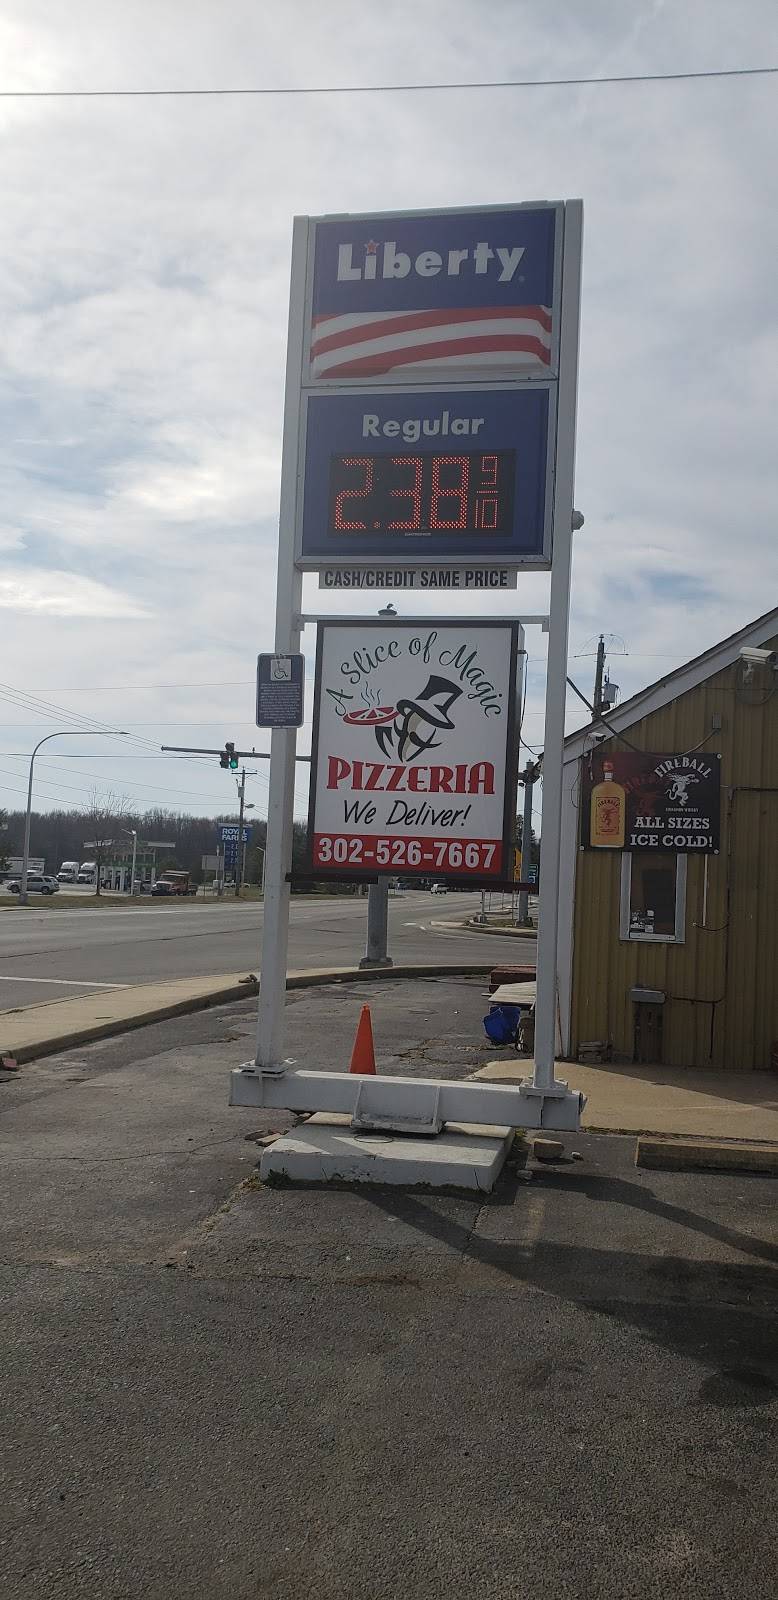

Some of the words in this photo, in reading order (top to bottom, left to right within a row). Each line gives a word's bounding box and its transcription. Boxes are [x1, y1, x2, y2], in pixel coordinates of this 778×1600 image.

[337, 240, 525, 282] Liberty
[362, 411, 485, 443] Regular
[334, 456, 470, 530] 2.38
[324, 571, 417, 588] CASH/CREDIT
[420, 571, 458, 587] SAME
[465, 570, 508, 586] PRICE
[325, 688, 354, 717] A
[340, 641, 402, 684] Slice
[408, 631, 438, 664] of
[438, 644, 502, 719] Magic
[326, 755, 495, 795] PIZZERIA
[655, 757, 712, 778] FIREBALL
[343, 799, 377, 825] We
[385, 800, 472, 827] Deliver!
[634, 816, 665, 829] ALL
[667, 817, 710, 830] SIZES
[318, 837, 496, 869] 302-526-7667
[630, 834, 659, 846] ICE
[662, 835, 713, 848] COLD!
